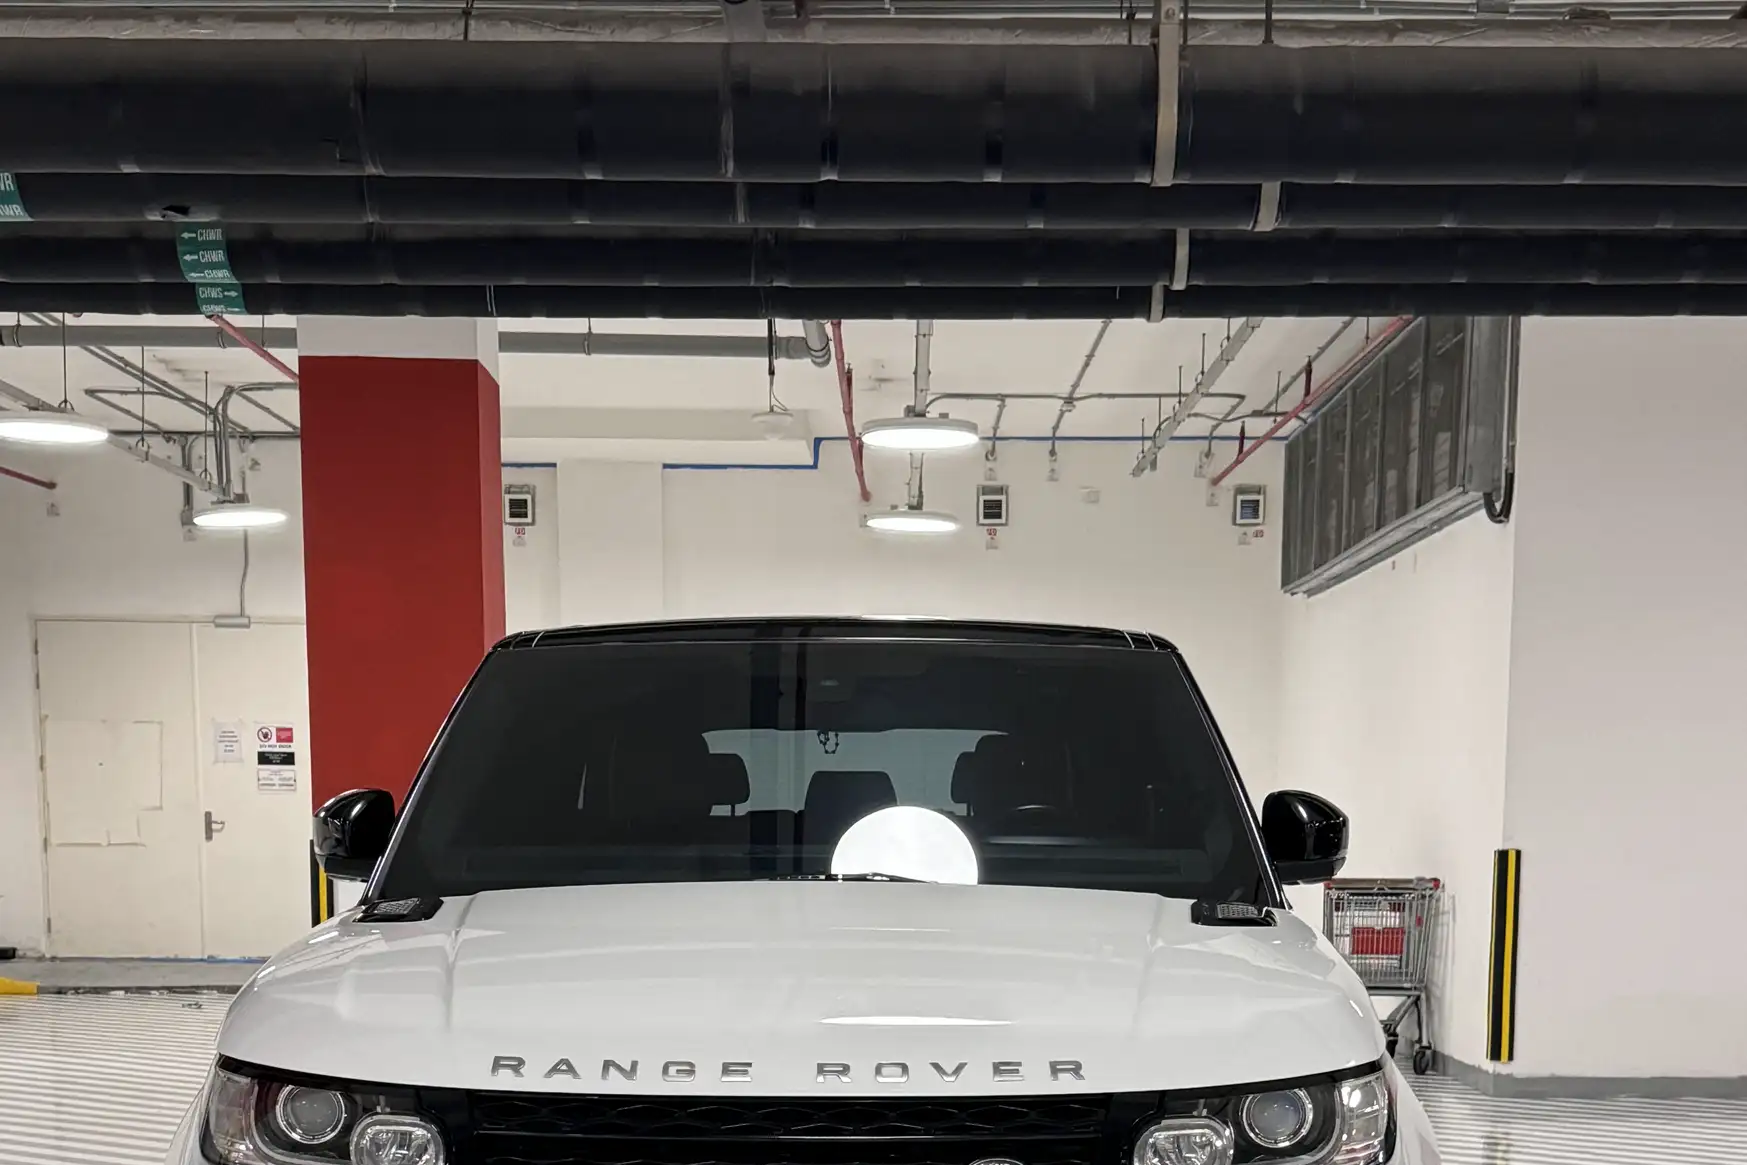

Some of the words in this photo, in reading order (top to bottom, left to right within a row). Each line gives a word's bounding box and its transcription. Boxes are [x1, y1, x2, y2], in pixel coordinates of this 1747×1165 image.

[197, 228, 223, 241] CHWR
[199, 249, 225, 263] CHWR
[204, 269, 230, 278] CHWR
[199, 287, 223, 299] CHWS
[490, 1055, 754, 1083] RANGE
[815, 1059, 1086, 1084] ROVER
